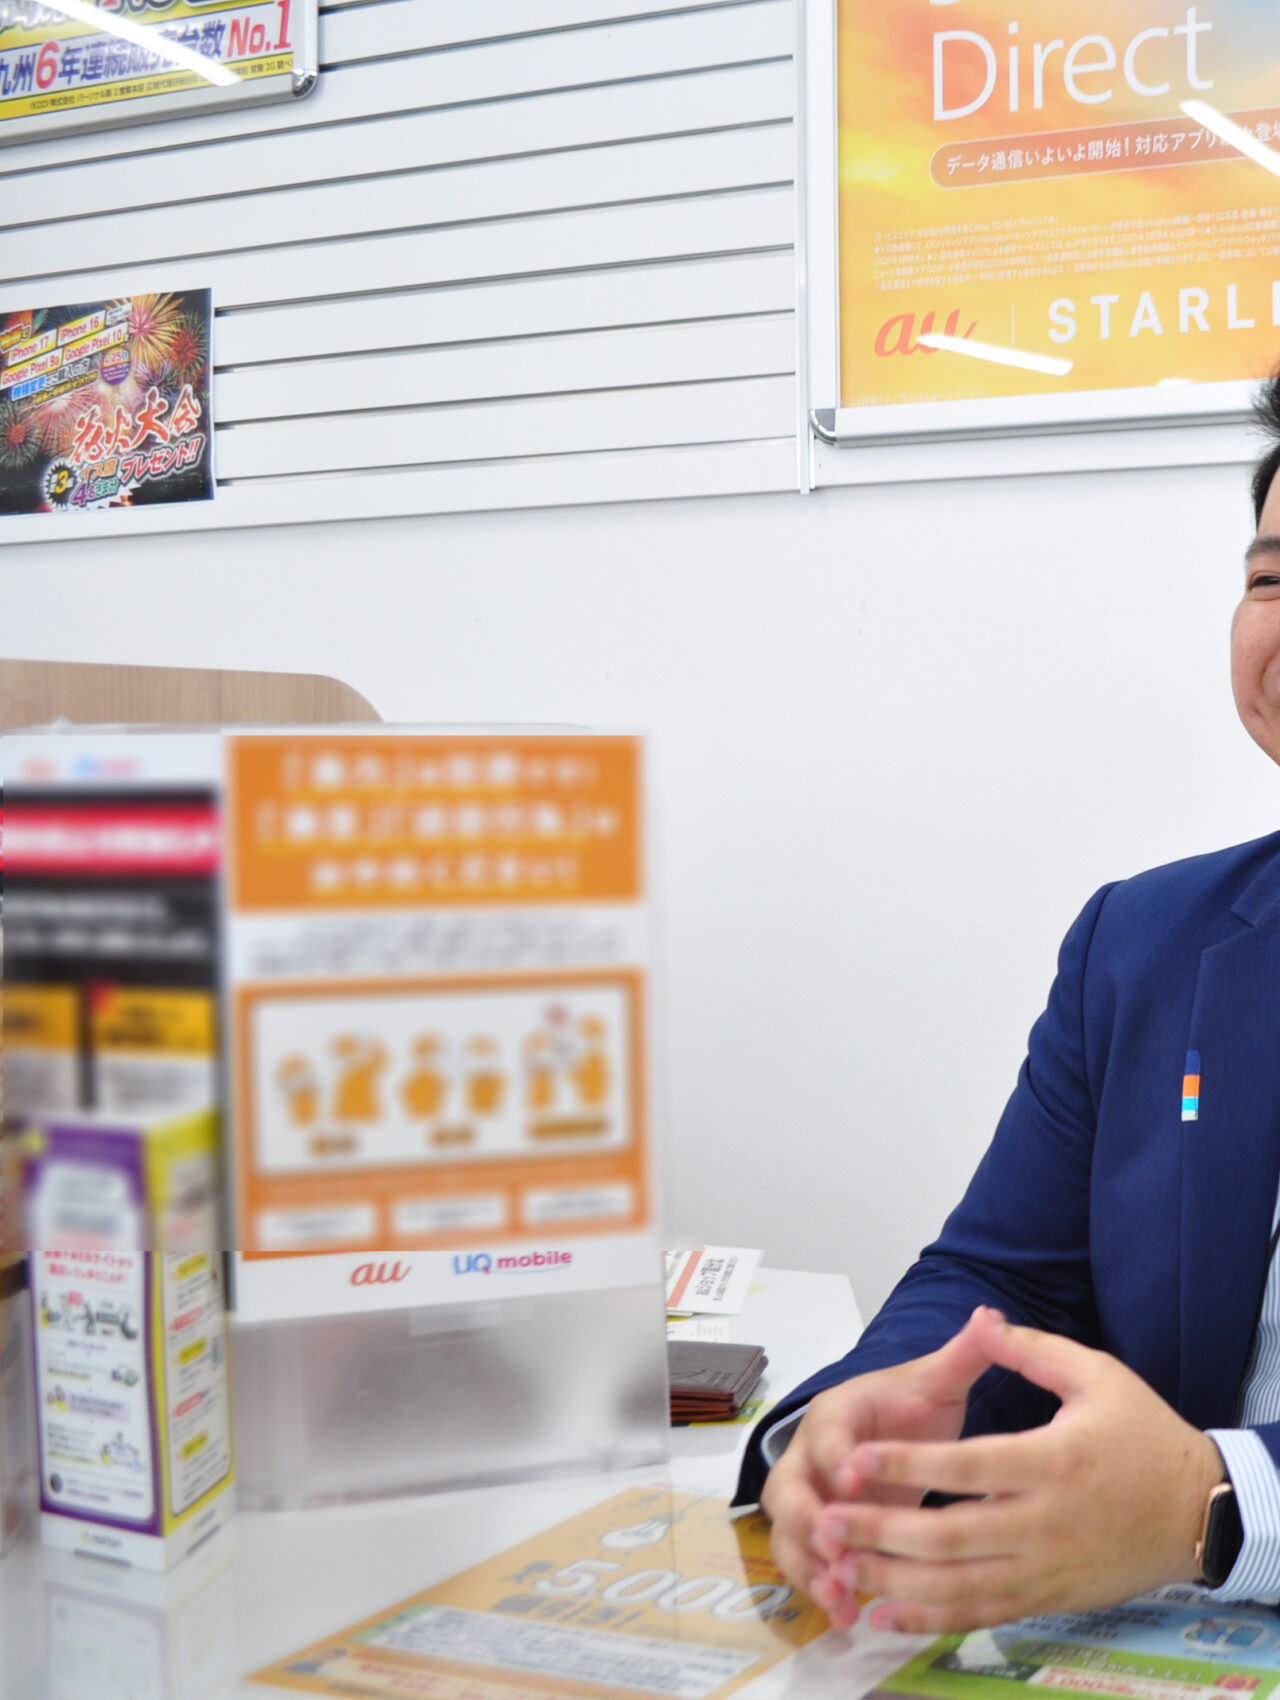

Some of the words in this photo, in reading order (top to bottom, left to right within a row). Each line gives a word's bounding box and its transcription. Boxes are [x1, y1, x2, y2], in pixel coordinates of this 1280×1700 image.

[933, 6, 1214, 122] Direct
[874, 309, 978, 357] au
[349, 1259, 412, 1286] au
[453, 1252, 492, 1275] UQ
[497, 1250, 573, 1268] mobile
